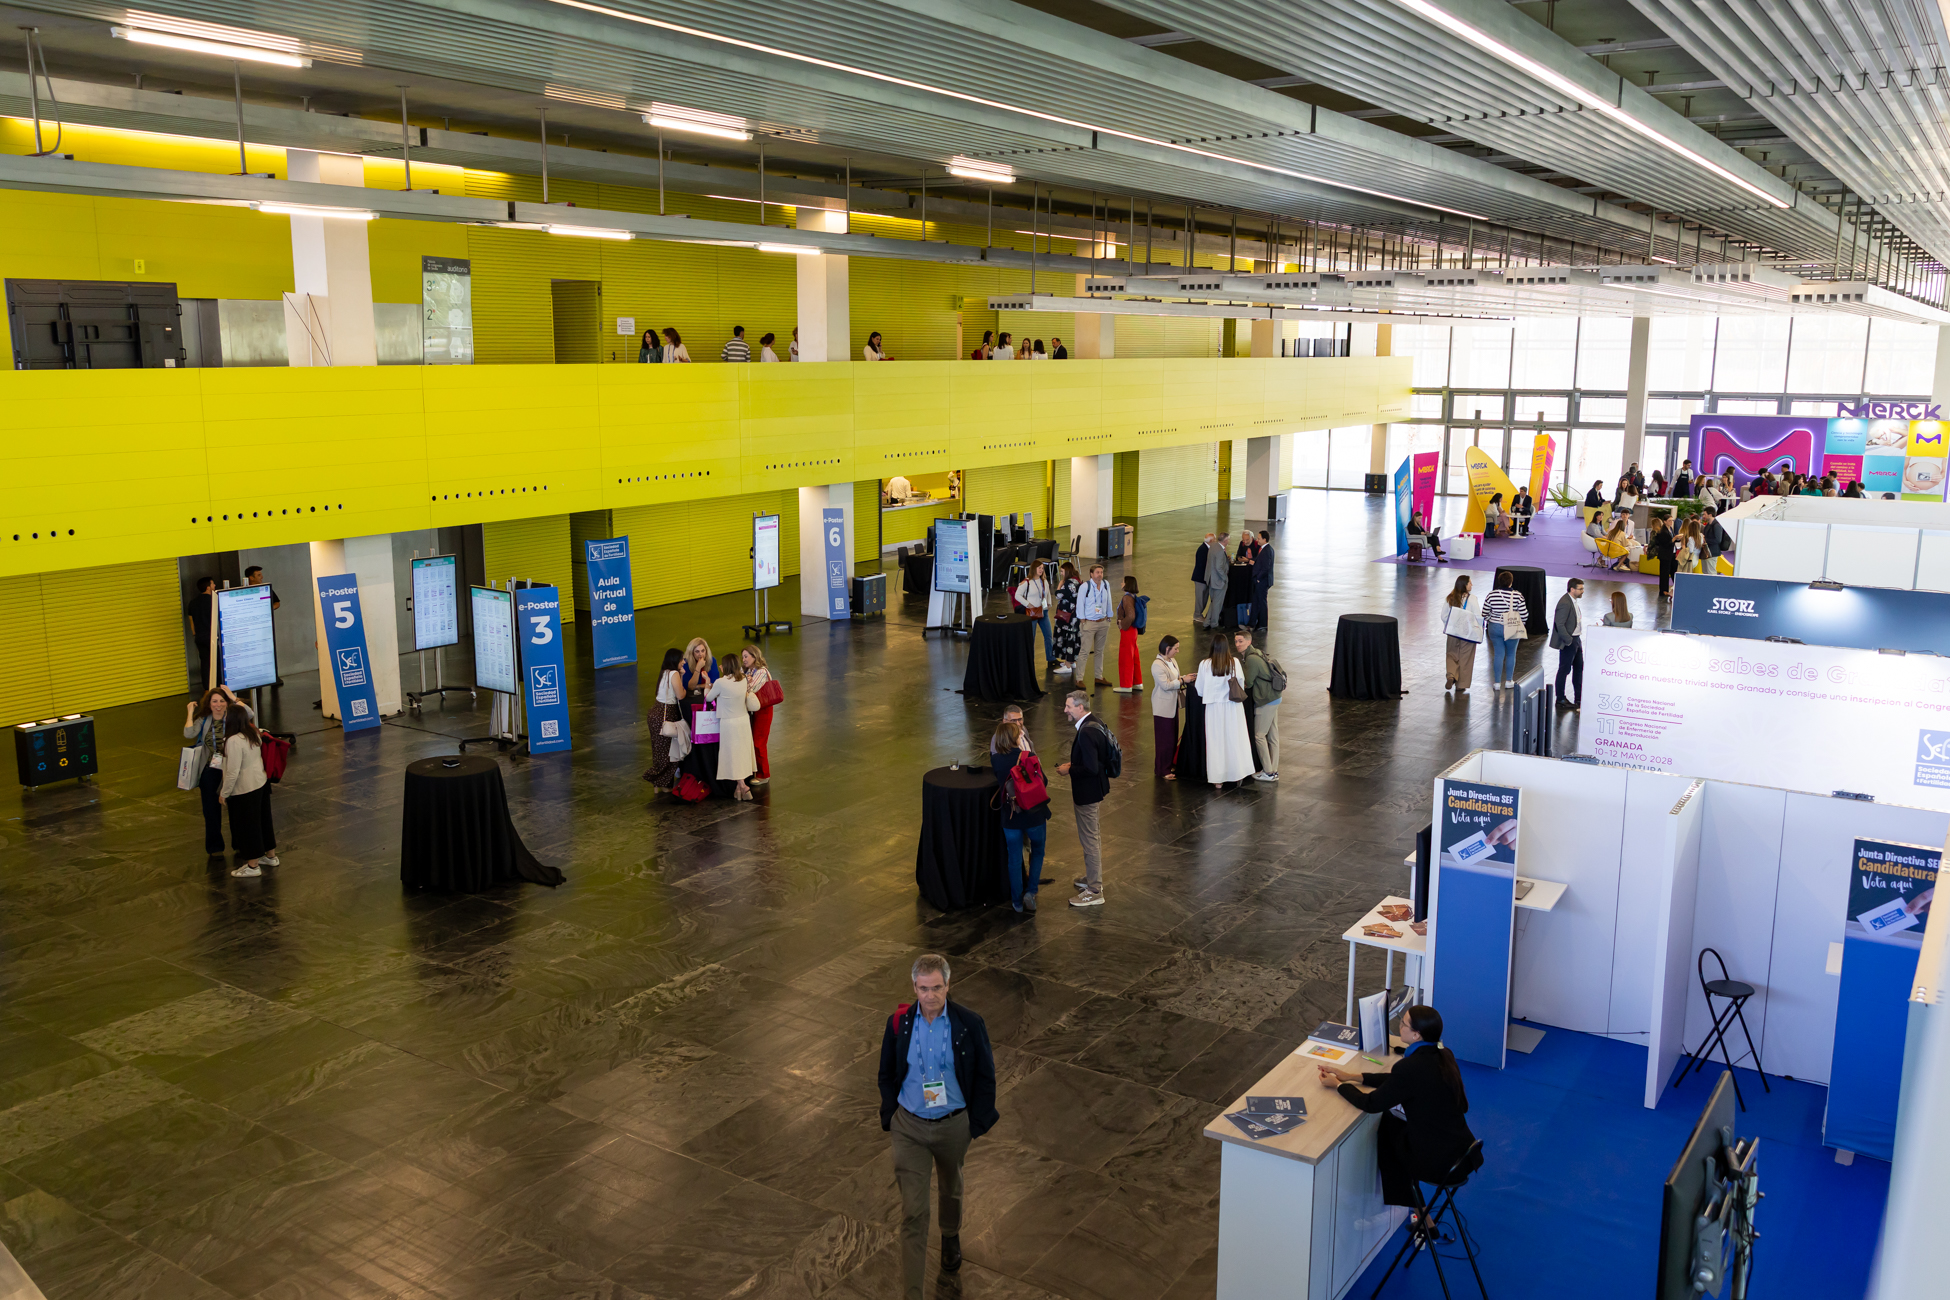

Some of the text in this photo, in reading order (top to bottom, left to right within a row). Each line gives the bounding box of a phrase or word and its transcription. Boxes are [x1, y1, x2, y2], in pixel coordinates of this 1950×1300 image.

[426, 280, 432, 291] 3
[427, 309, 432, 320] 2
[829, 527, 840, 547] 6
[598, 576, 619, 587] Aula
[320, 586, 358, 597] e-Poster
[593, 587, 626, 600] Virtual
[519, 601, 558, 611] e-Poster
[604, 602, 616, 612] de
[1713, 598, 1755, 612] STORZ
[333, 601, 355, 628] 5
[592, 614, 633, 626] e-Poster
[530, 616, 553, 645] 3
[1708, 657, 1778, 677] sabes
[1787, 662, 1818, 681] de
[1601, 669, 1637, 679] Participa
[1652, 675, 1682, 684] nuestro
[1685, 679, 1708, 687] trivial
[1710, 681, 1734, 690] sobre
[1737, 683, 1776, 694] Granada
[1786, 689, 1827, 699] consigue
[1598, 693, 1623, 711] 36
[1597, 718, 1614, 734] 11
[1595, 738, 1643, 751] GRANADA
[1595, 748, 1672, 765] 10-12 MAYO 2028
[1598, 759, 1662, 772] ANDIDATURA
[1448, 787, 1513, 804] Junta Directiva SEF
[1448, 796, 1513, 816] Candidaturas
[1452, 809, 1470, 824] Vota
[1858, 848, 1883, 859] Junta
[1885, 852, 1925, 866] Directiva
[1862, 872, 1886, 889] Vota
